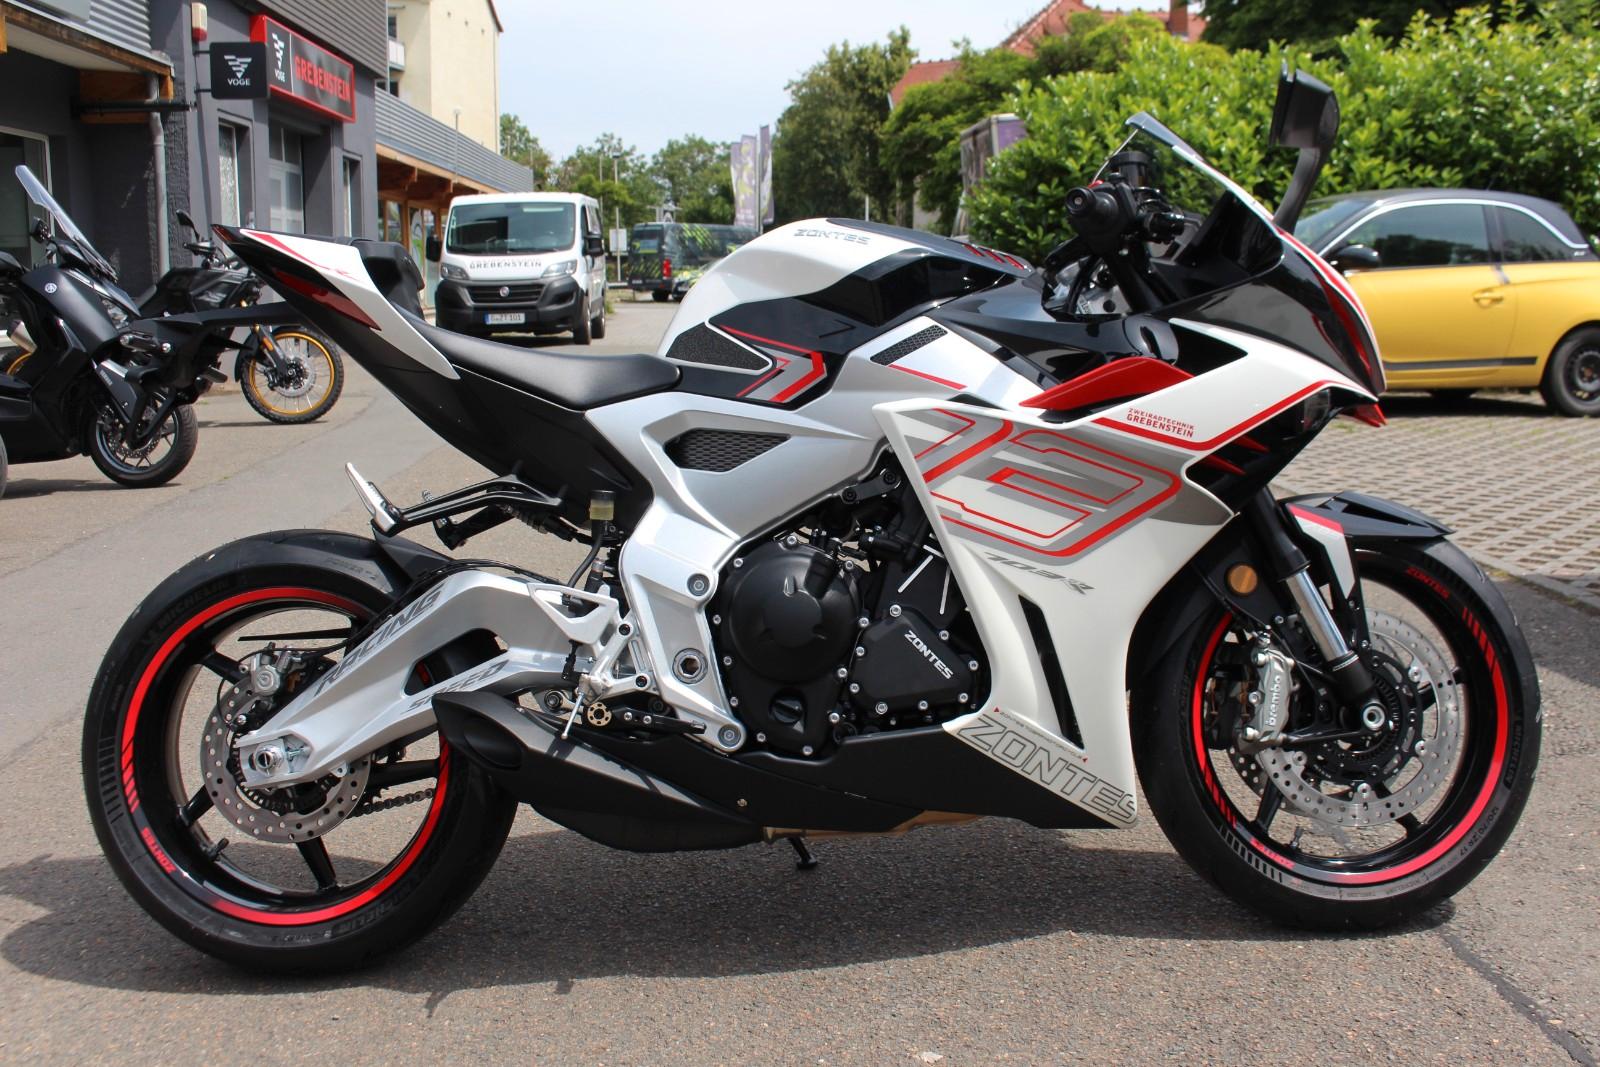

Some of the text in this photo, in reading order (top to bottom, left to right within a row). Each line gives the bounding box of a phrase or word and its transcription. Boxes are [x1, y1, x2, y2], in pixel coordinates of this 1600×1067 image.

[227, 78, 251, 87] VOGE
[294, 55, 351, 100] GREBENSTEIN
[794, 229, 871, 245] ZONTES
[469, 260, 543, 270] GREBENSTEIN
[1126, 413, 1194, 438] GREBENSTEIN
[1128, 407, 1194, 430] ZWEIRADTECHNIK
[314, 581, 445, 697] RACING
[904, 630, 954, 679] ZONTES
[1265, 674, 1281, 727] brembo
[956, 713, 1138, 824] ZONTES
